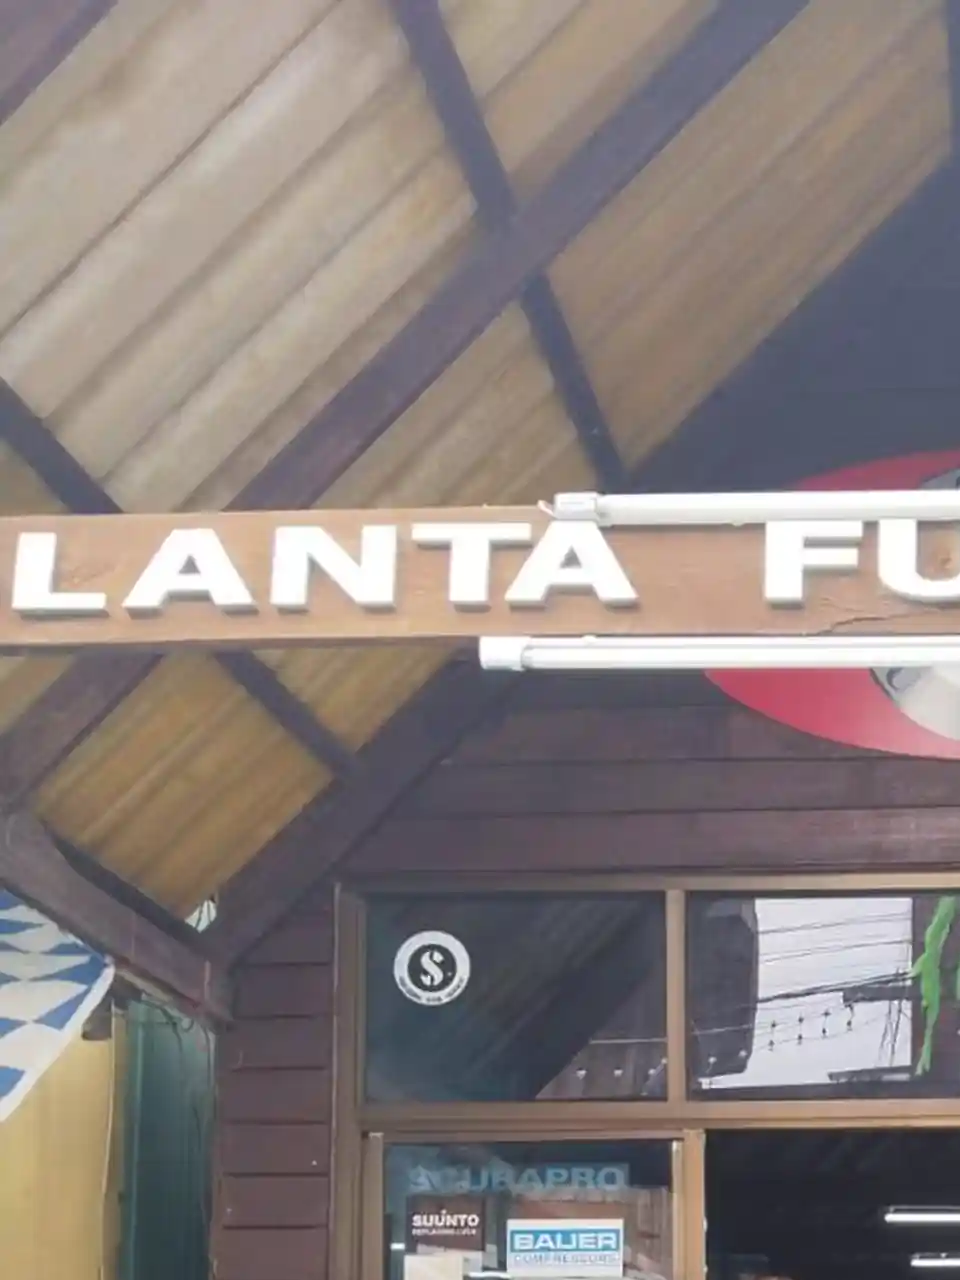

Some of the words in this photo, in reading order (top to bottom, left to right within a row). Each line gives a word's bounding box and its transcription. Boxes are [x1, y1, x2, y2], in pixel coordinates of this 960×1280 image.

[13, 520, 636, 611] LANTA
[408, 1165, 626, 1193] SCUBAPRO
[412, 1209, 479, 1227] SUUNTO
[513, 1232, 617, 1250] BAUER
